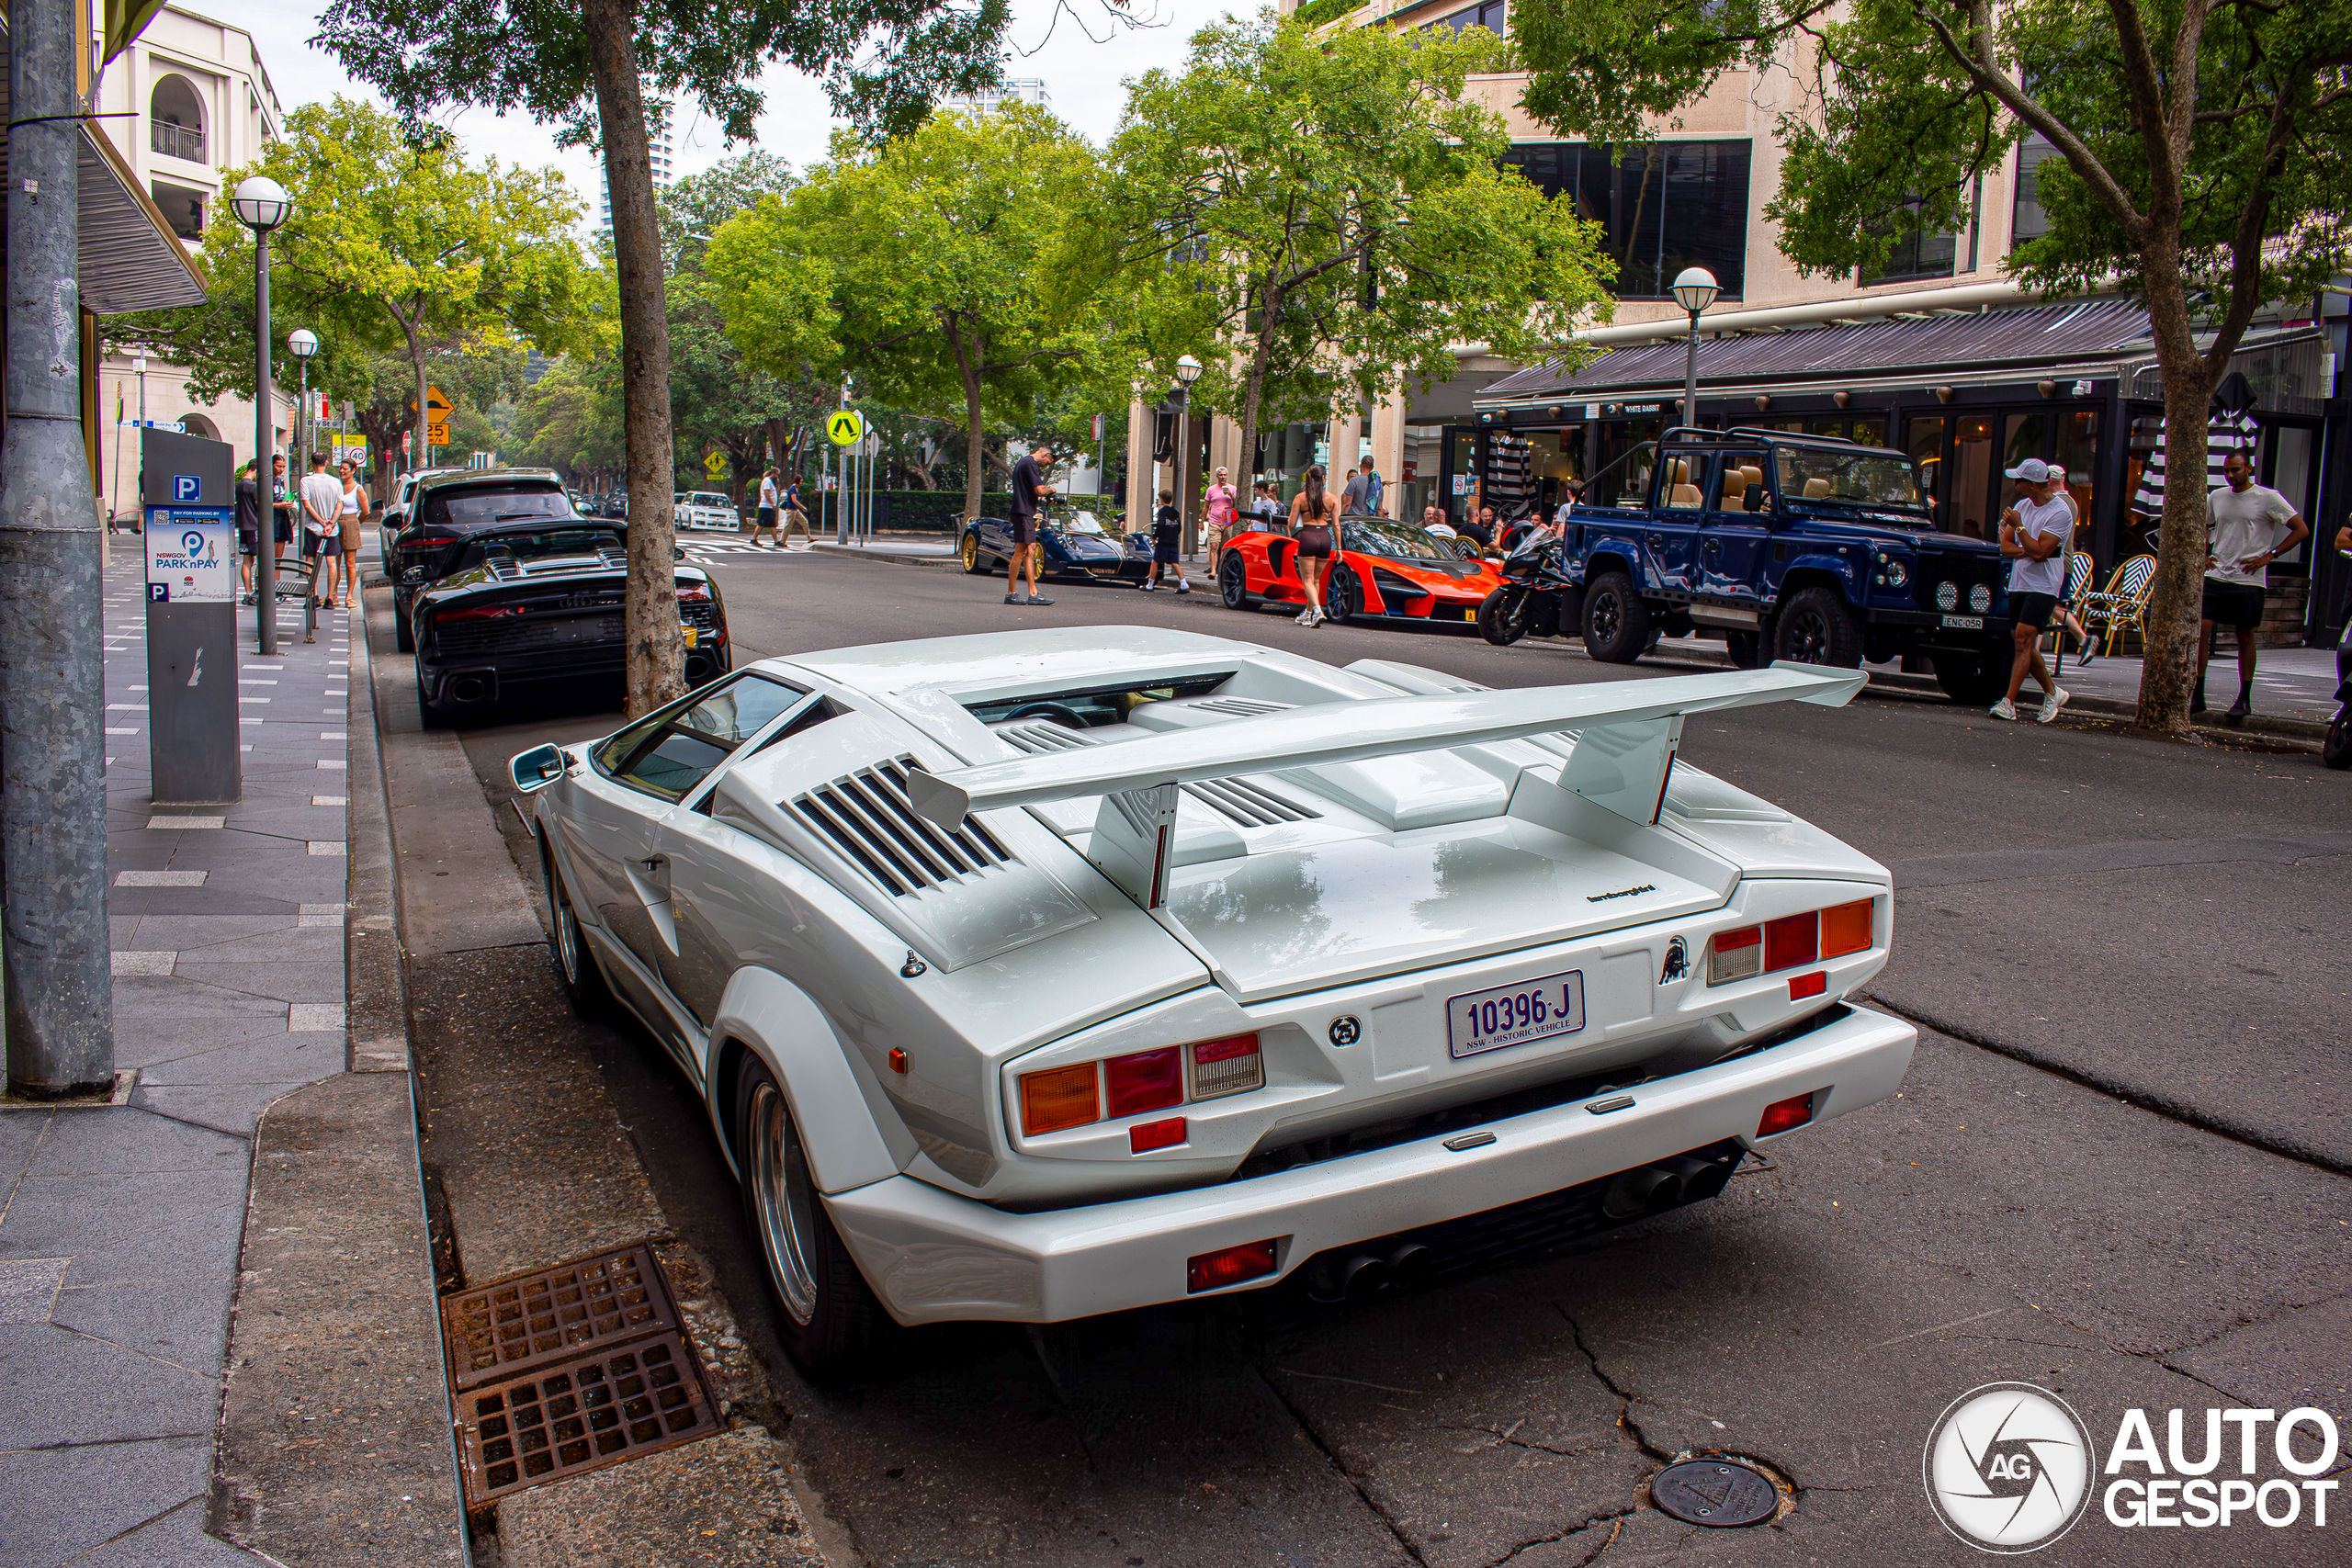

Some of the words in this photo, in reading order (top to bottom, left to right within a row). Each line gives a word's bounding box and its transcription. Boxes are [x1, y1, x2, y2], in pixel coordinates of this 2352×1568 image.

[1642, 404, 1660, 412] RABBIT
[307, 419, 321, 427] By
[427, 425, 443, 436] 25
[178, 478, 196, 499] P
[153, 585, 164, 600] P
[1466, 1039, 1487, 1050] NSW
[1494, 1028, 1533, 1043] HISTORIC
[1535, 1020, 1570, 1033] VEHICLE
